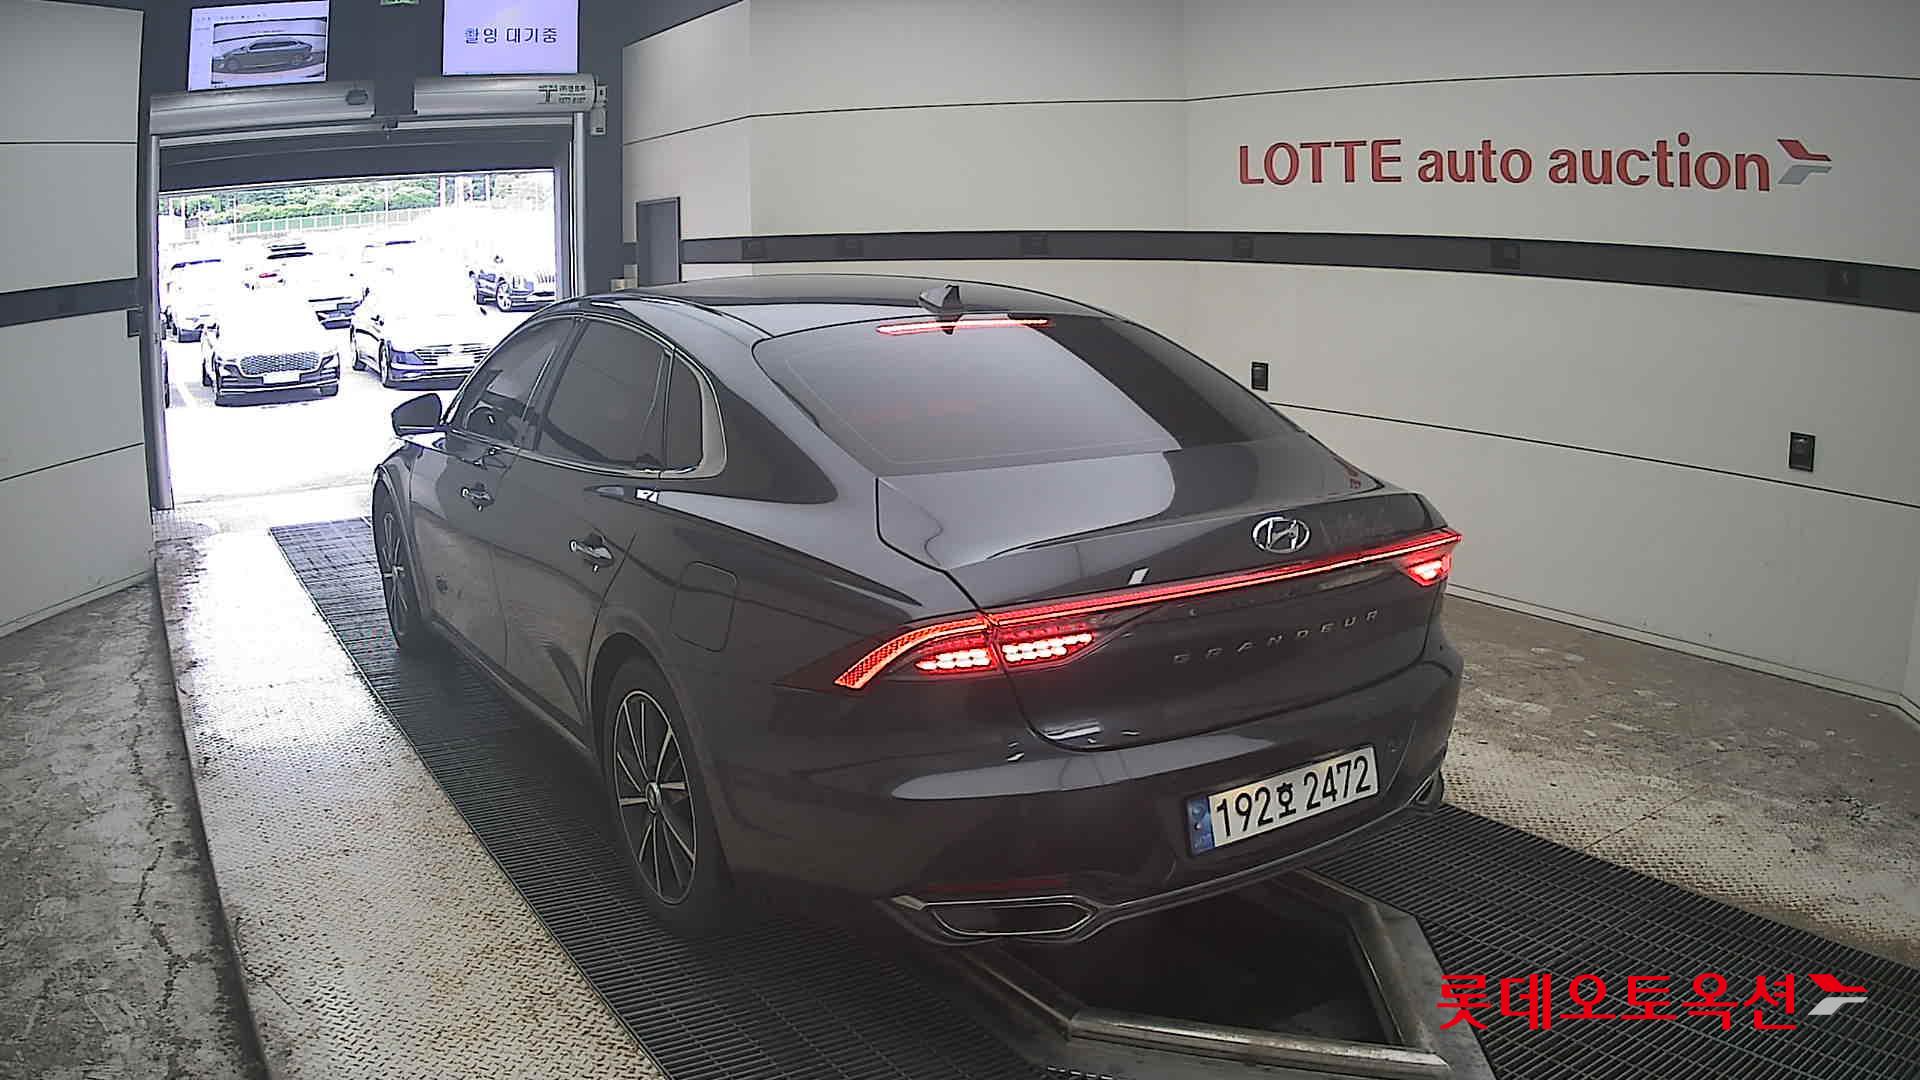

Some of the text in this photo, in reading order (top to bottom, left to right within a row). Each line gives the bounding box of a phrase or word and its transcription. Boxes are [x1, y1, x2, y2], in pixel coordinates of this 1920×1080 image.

[506, 27, 558, 44] 대기중
[1239, 132, 1771, 193] LOTTE auto auction
[1173, 609, 1379, 664] GRANDEUR
[1215, 782, 1297, 838] 192호
[1303, 755, 1371, 812] 2472
